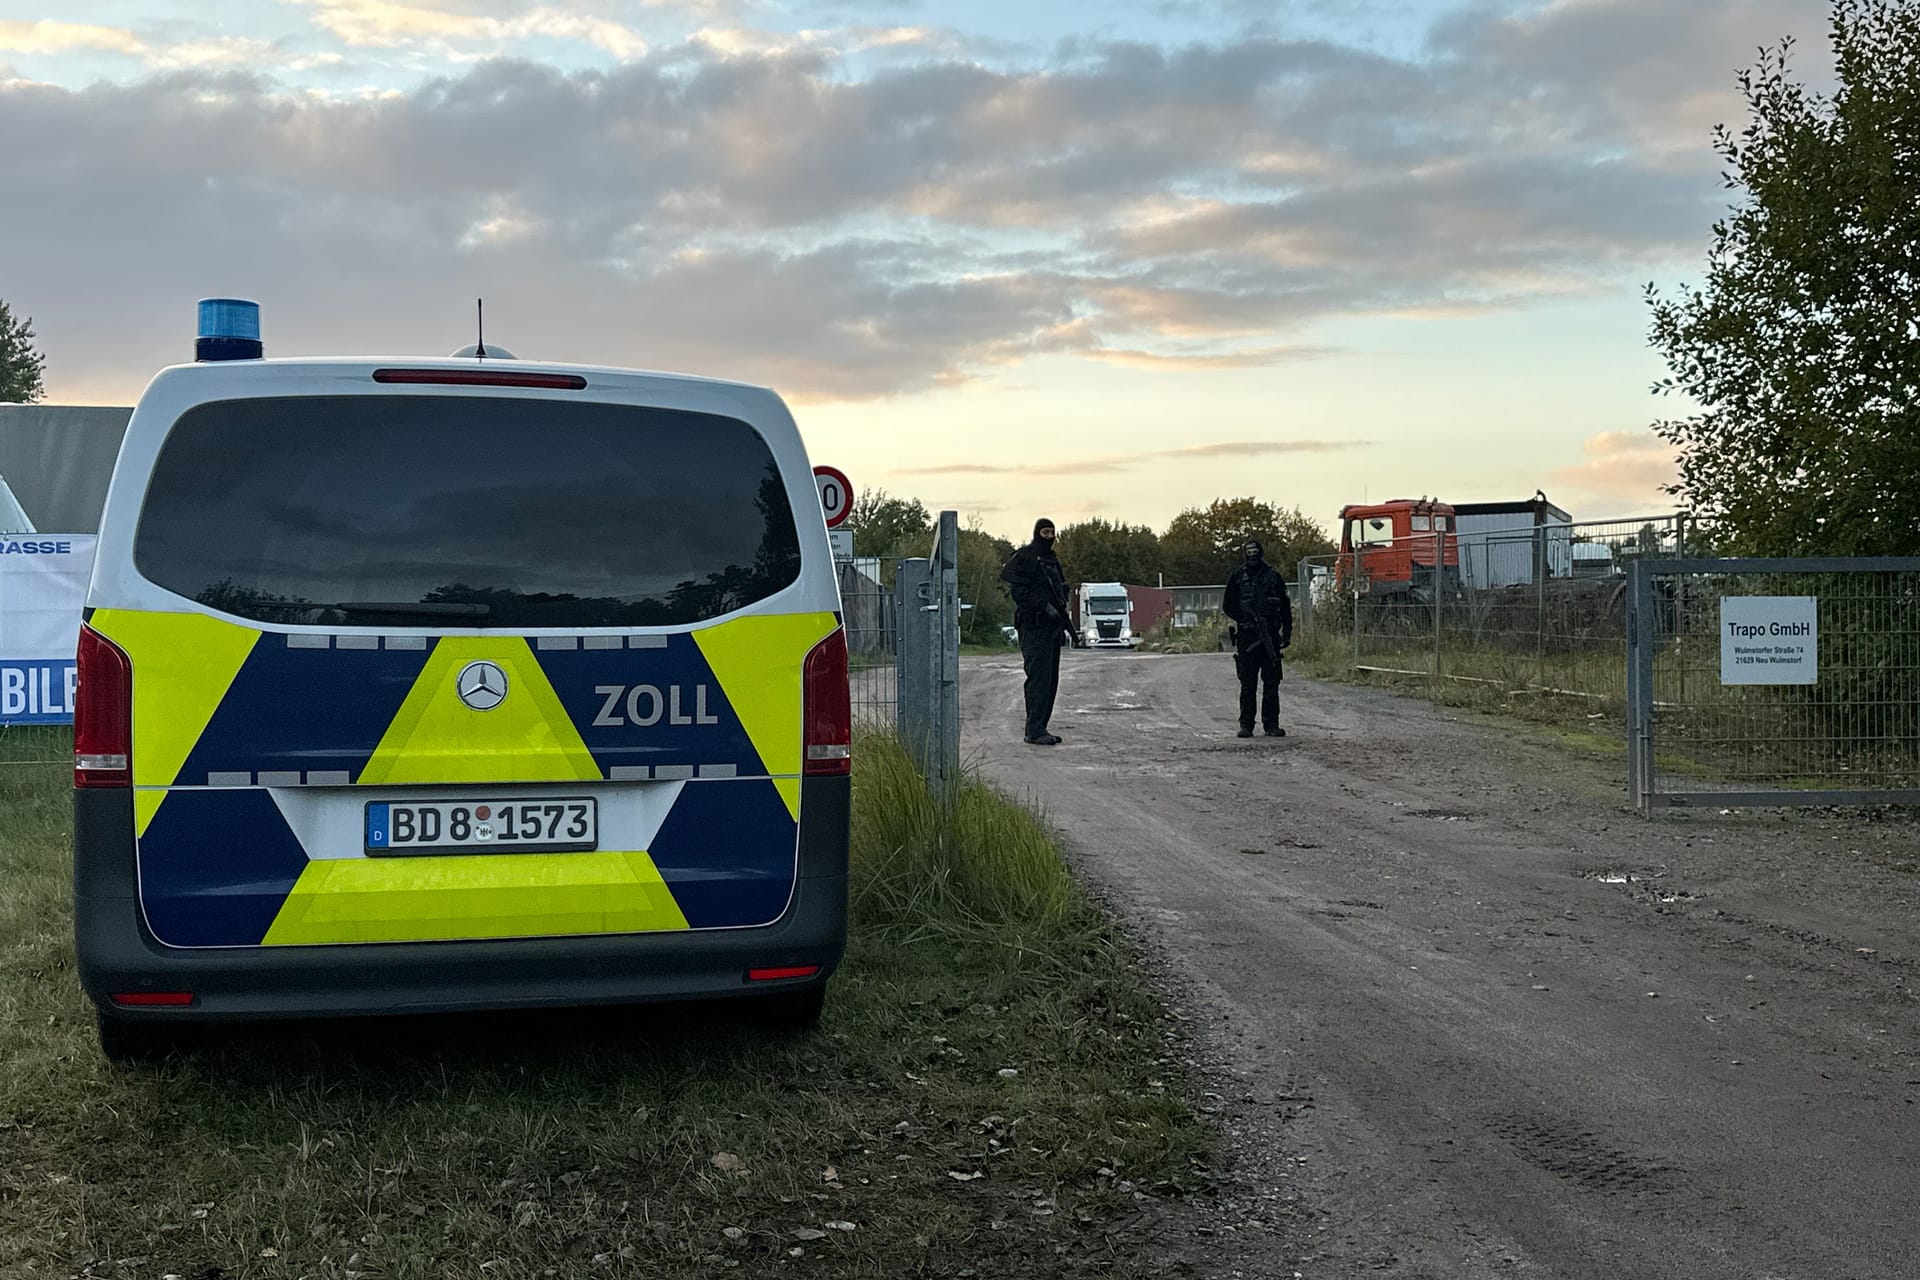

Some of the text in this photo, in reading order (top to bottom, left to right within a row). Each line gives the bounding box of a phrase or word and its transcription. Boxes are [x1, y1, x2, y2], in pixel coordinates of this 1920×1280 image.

[1728, 622, 1810, 639] Trapo GmbH
[1774, 646, 1795, 654] Straße
[1756, 656, 1769, 664] Neu
[1769, 656, 1802, 664] Wulmstorf
[592, 684, 718, 727] ZOLL
[392, 805, 588, 843] BD 8 1573
[374, 831, 382, 841] D
